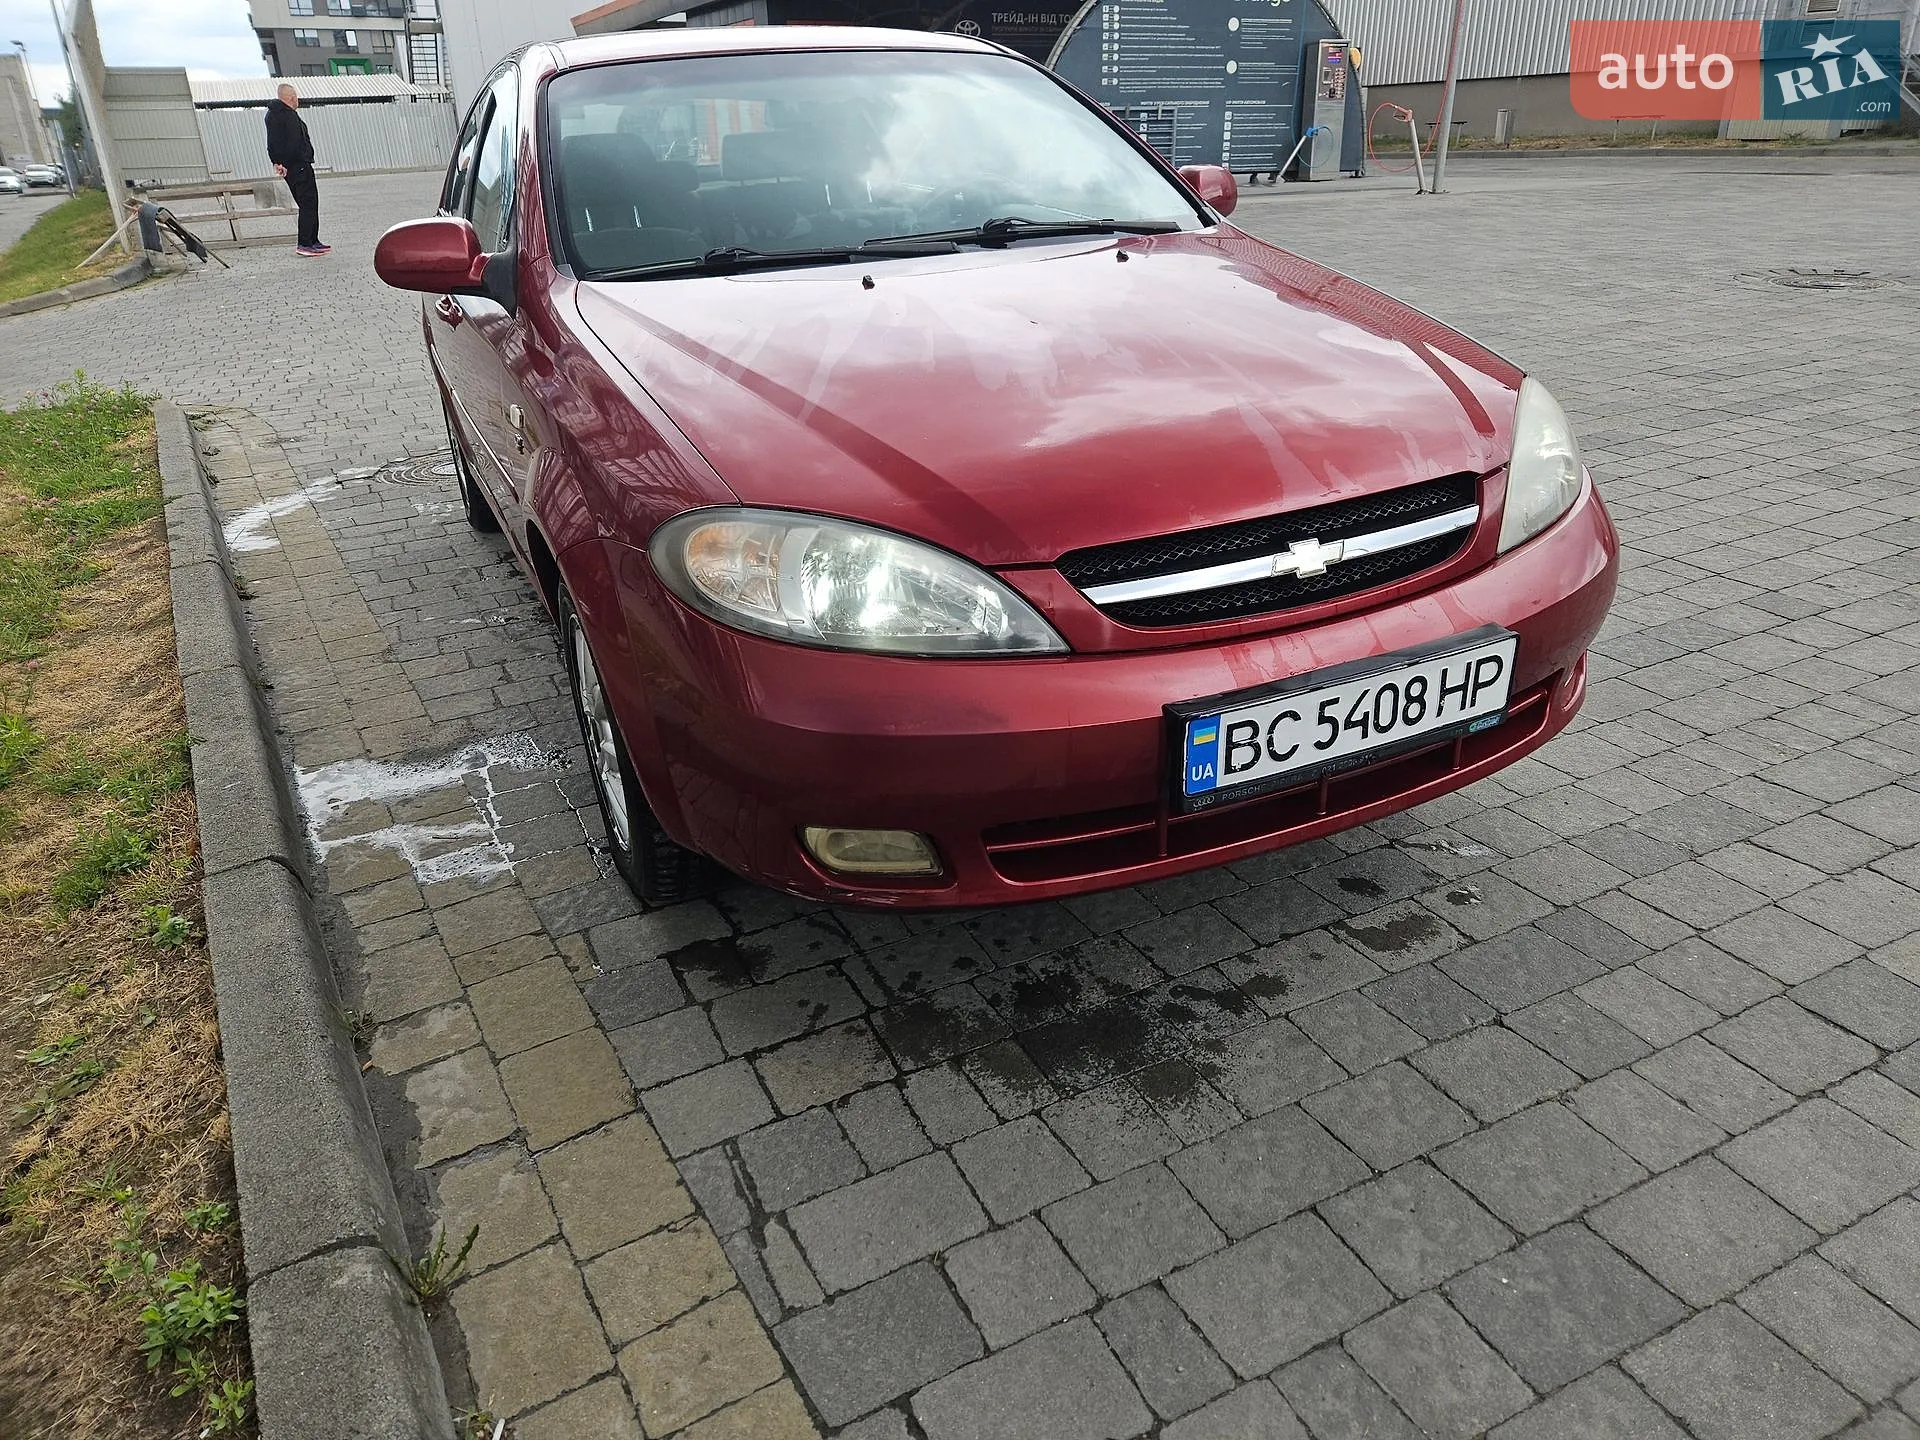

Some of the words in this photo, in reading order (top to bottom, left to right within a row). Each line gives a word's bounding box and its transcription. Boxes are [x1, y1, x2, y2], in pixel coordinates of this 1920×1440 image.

[991, 10, 1038, 25] ТРЕЙД-ІН
[1041, 13, 1057, 25] ВІД
[1058, 14, 1073, 24] ТО
[1223, 709, 1302, 776] BC
[1313, 675, 1429, 751] 5408
[1435, 655, 1505, 718] HP
[1191, 766, 1215, 783] UA
